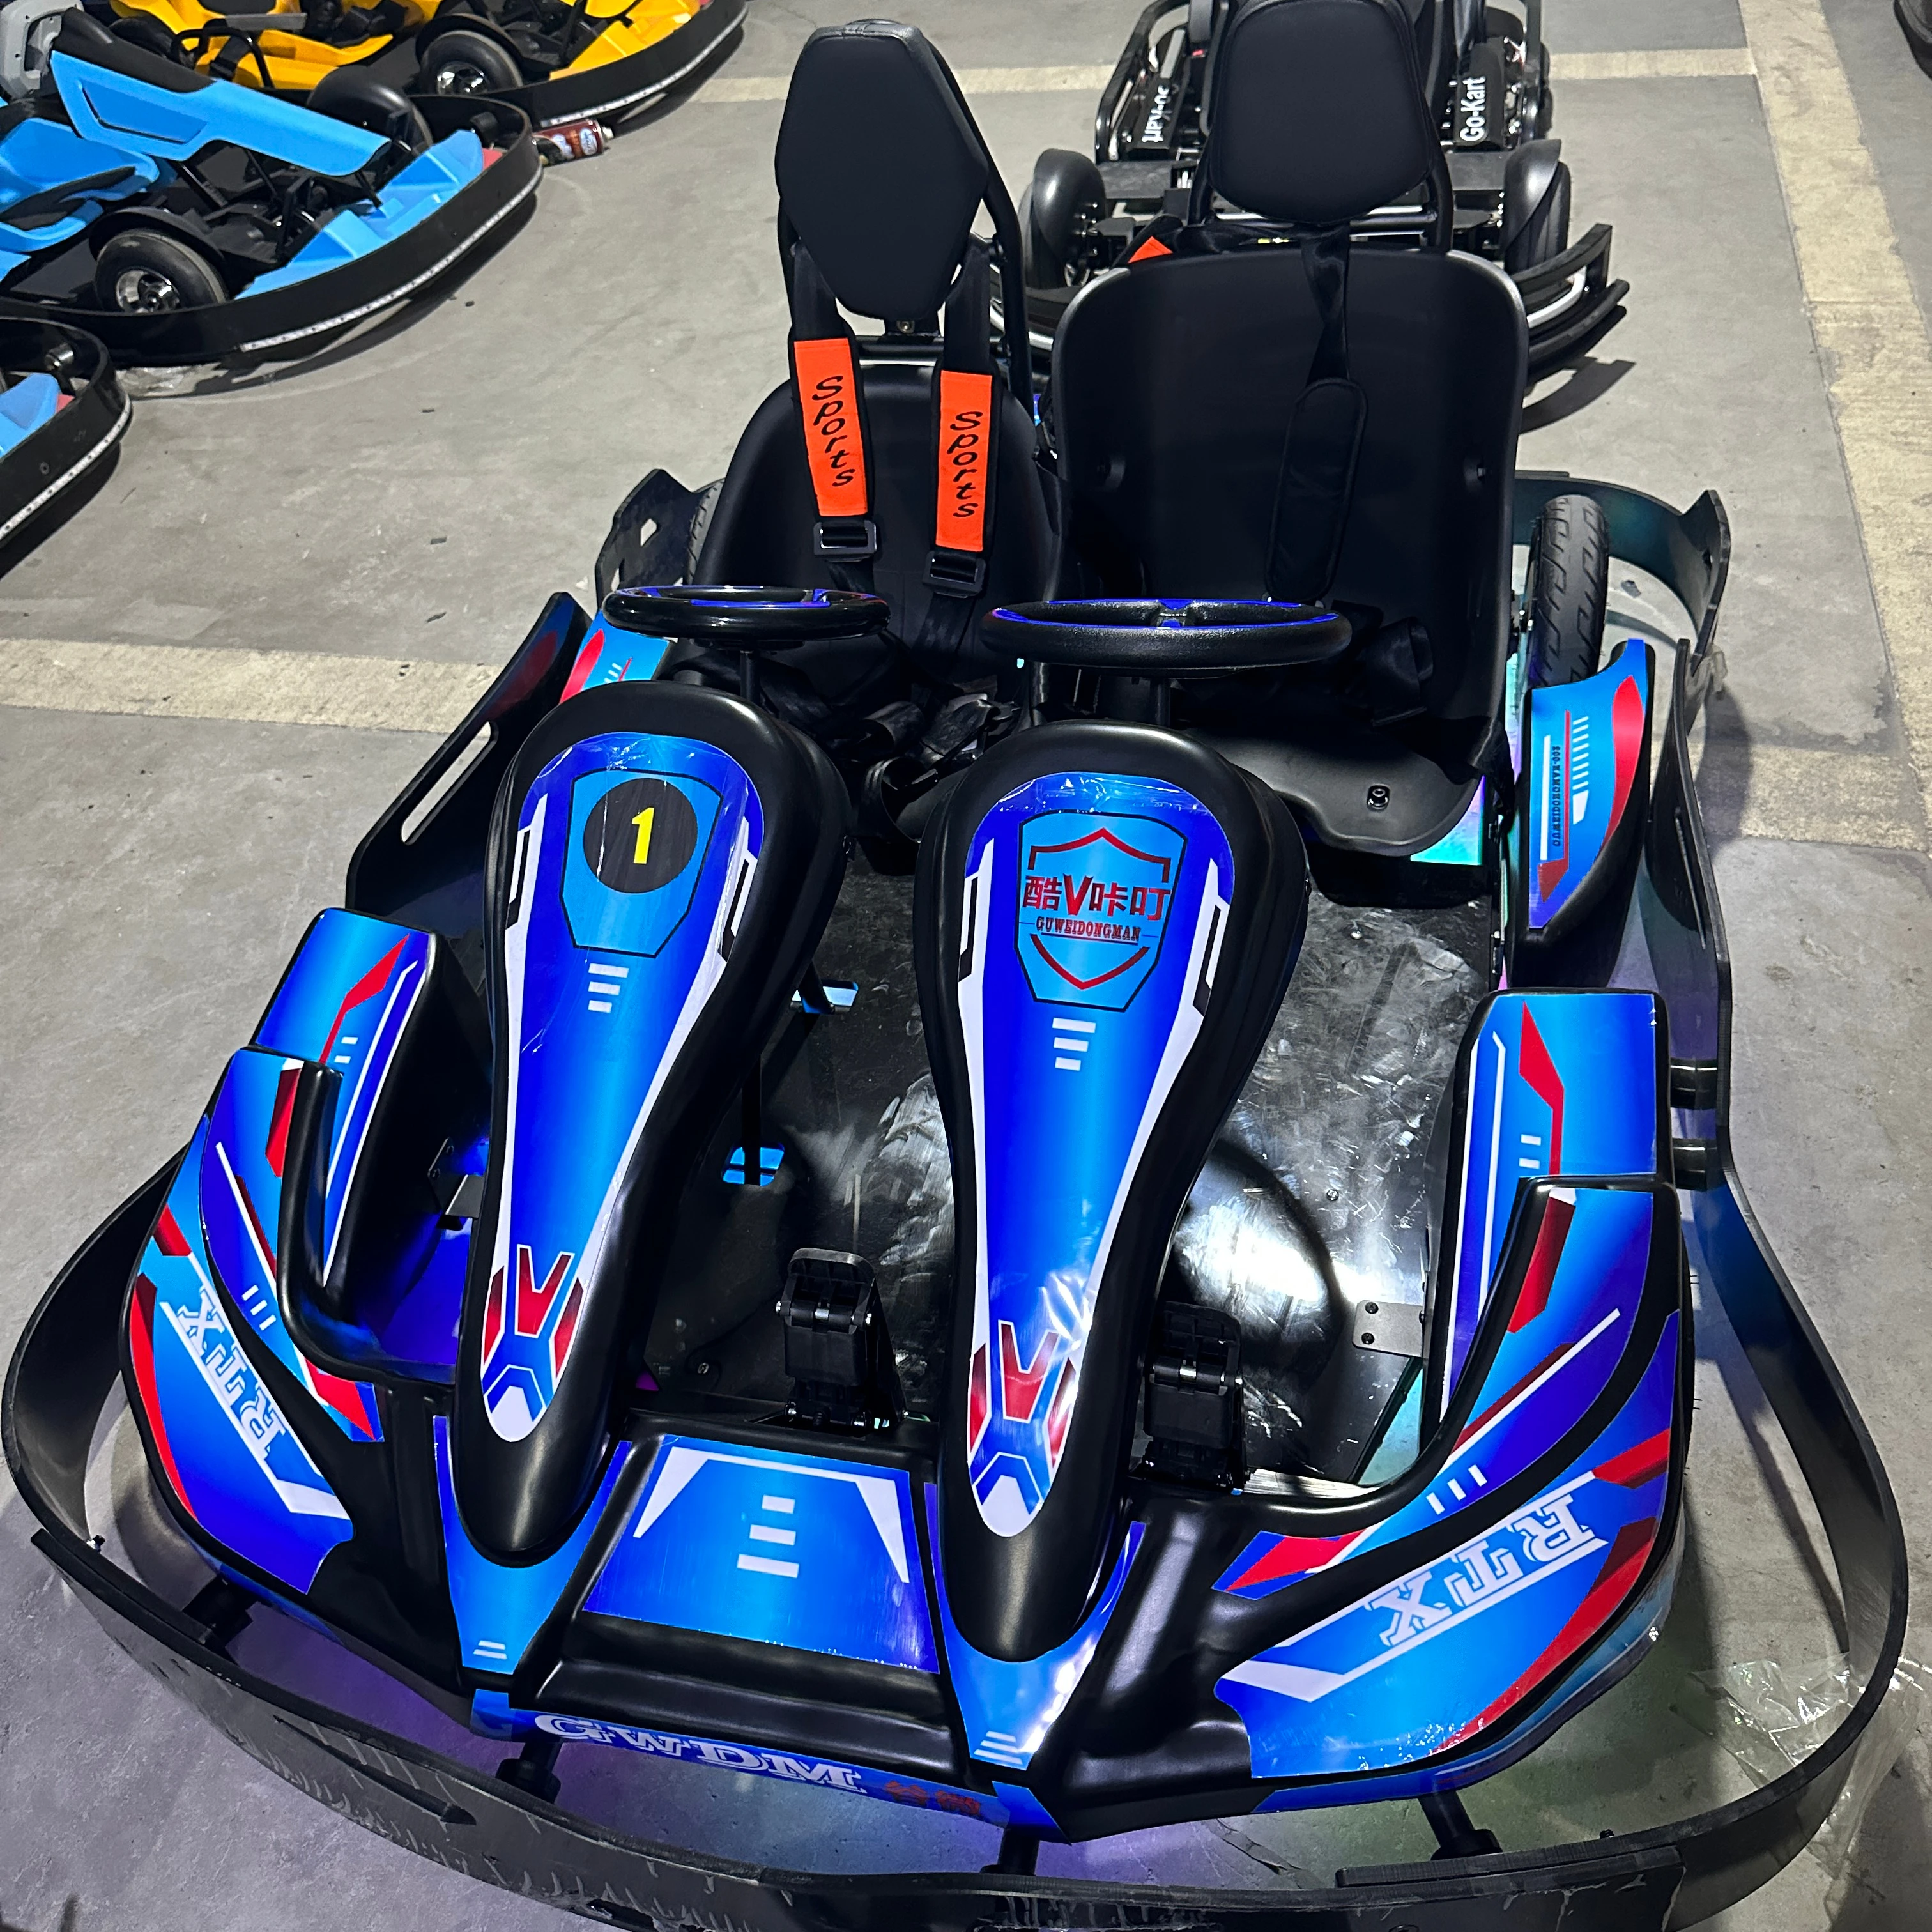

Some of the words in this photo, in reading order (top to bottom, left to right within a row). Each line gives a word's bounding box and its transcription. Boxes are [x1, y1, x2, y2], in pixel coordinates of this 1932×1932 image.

[1459, 76, 1487, 142] Go-Kart
[811, 376, 856, 487] Sports
[946, 411, 984, 519] Sports
[631, 807, 656, 865] 1
[1022, 873, 1171, 922] 酷V咔叮
[1036, 916, 1142, 942] GUWEIDONGMAN
[176, 1285, 288, 1459] RTX
[1365, 1491, 1595, 1646] RTX
[534, 1713, 868, 1795] GWDM
